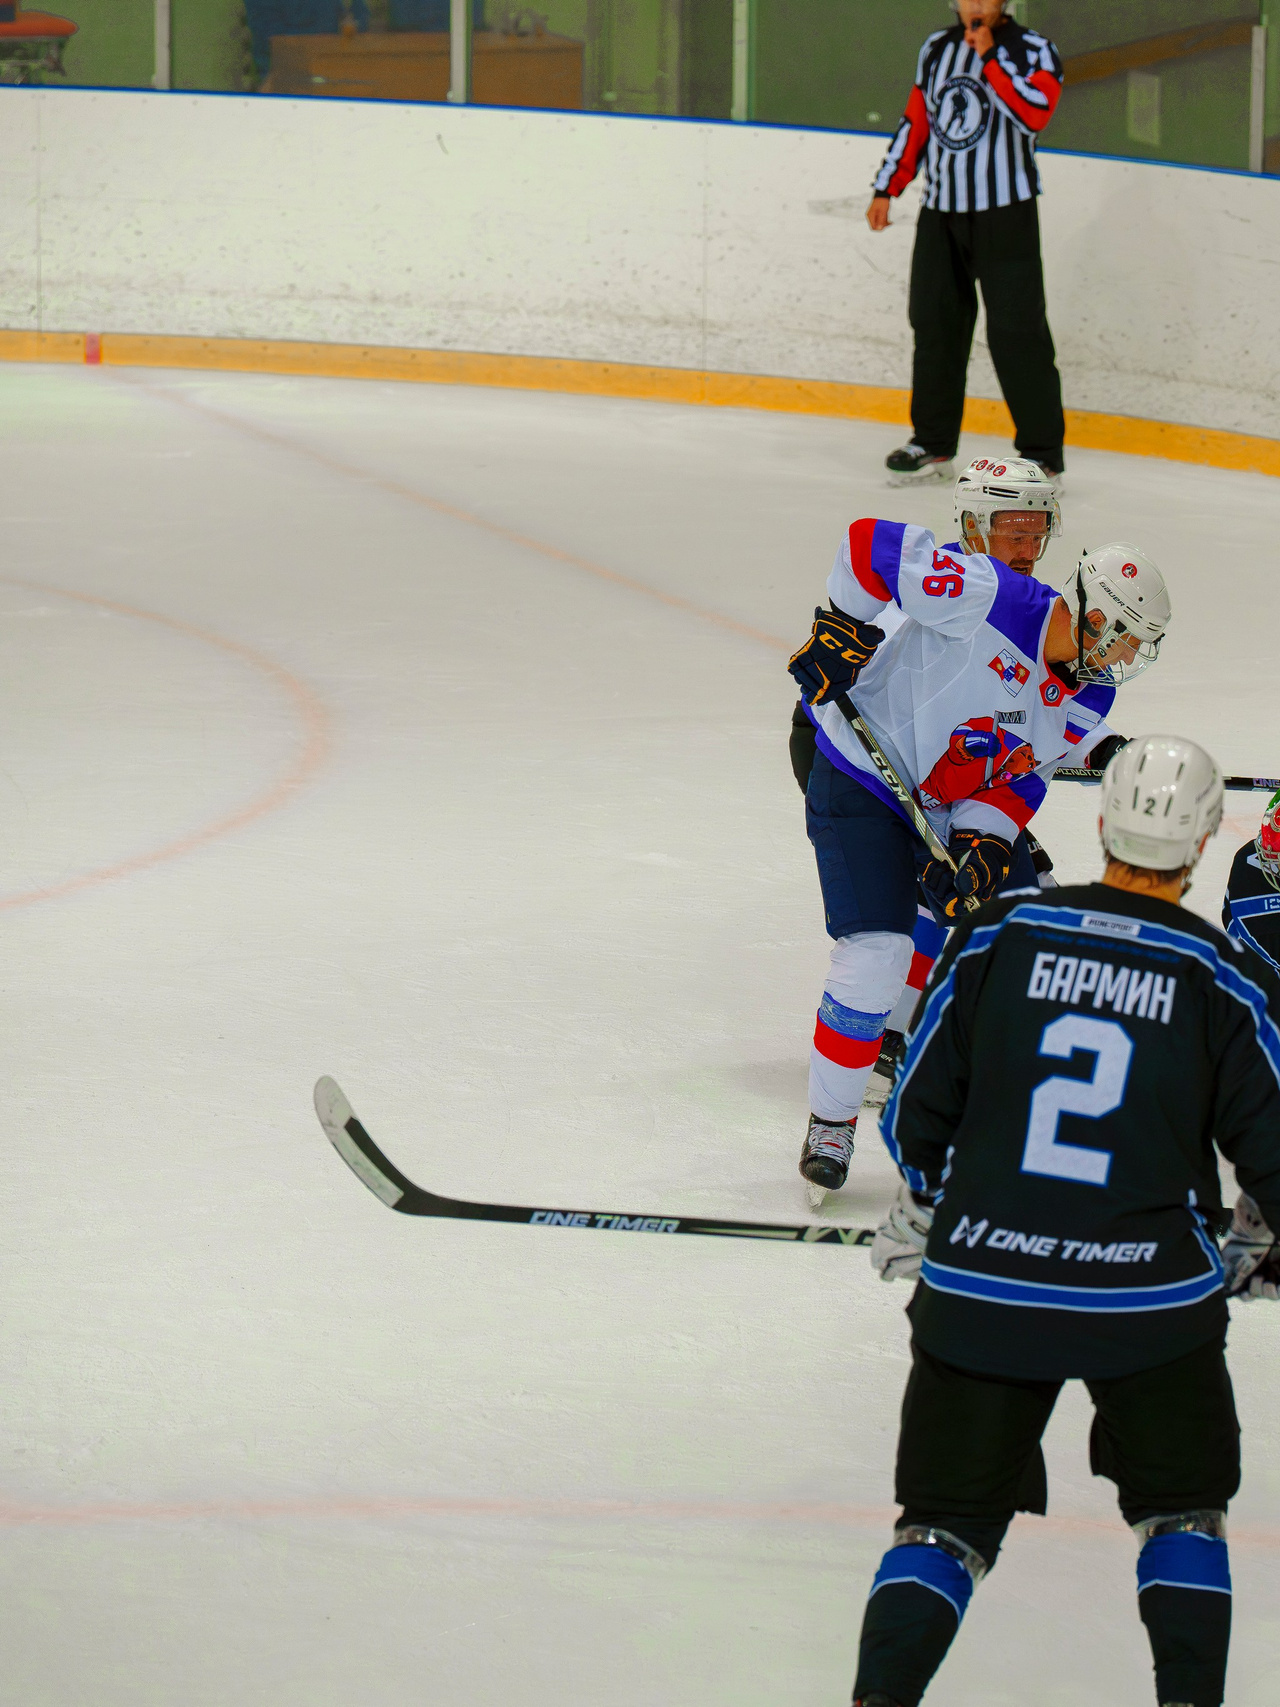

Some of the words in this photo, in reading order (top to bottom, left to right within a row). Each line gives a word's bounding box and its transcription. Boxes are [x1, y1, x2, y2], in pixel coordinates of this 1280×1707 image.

[870, 750, 910, 802] CCM
[1143, 796, 1156, 816] 2
[1026, 951, 1178, 1025] БАРМИН
[1018, 1011, 1135, 1187] 2
[528, 1210, 592, 1228] ONE
[594, 1213, 681, 1233] TIMER
[985, 1227, 1055, 1258] ONE
[1060, 1238, 1160, 1265] TIMER
